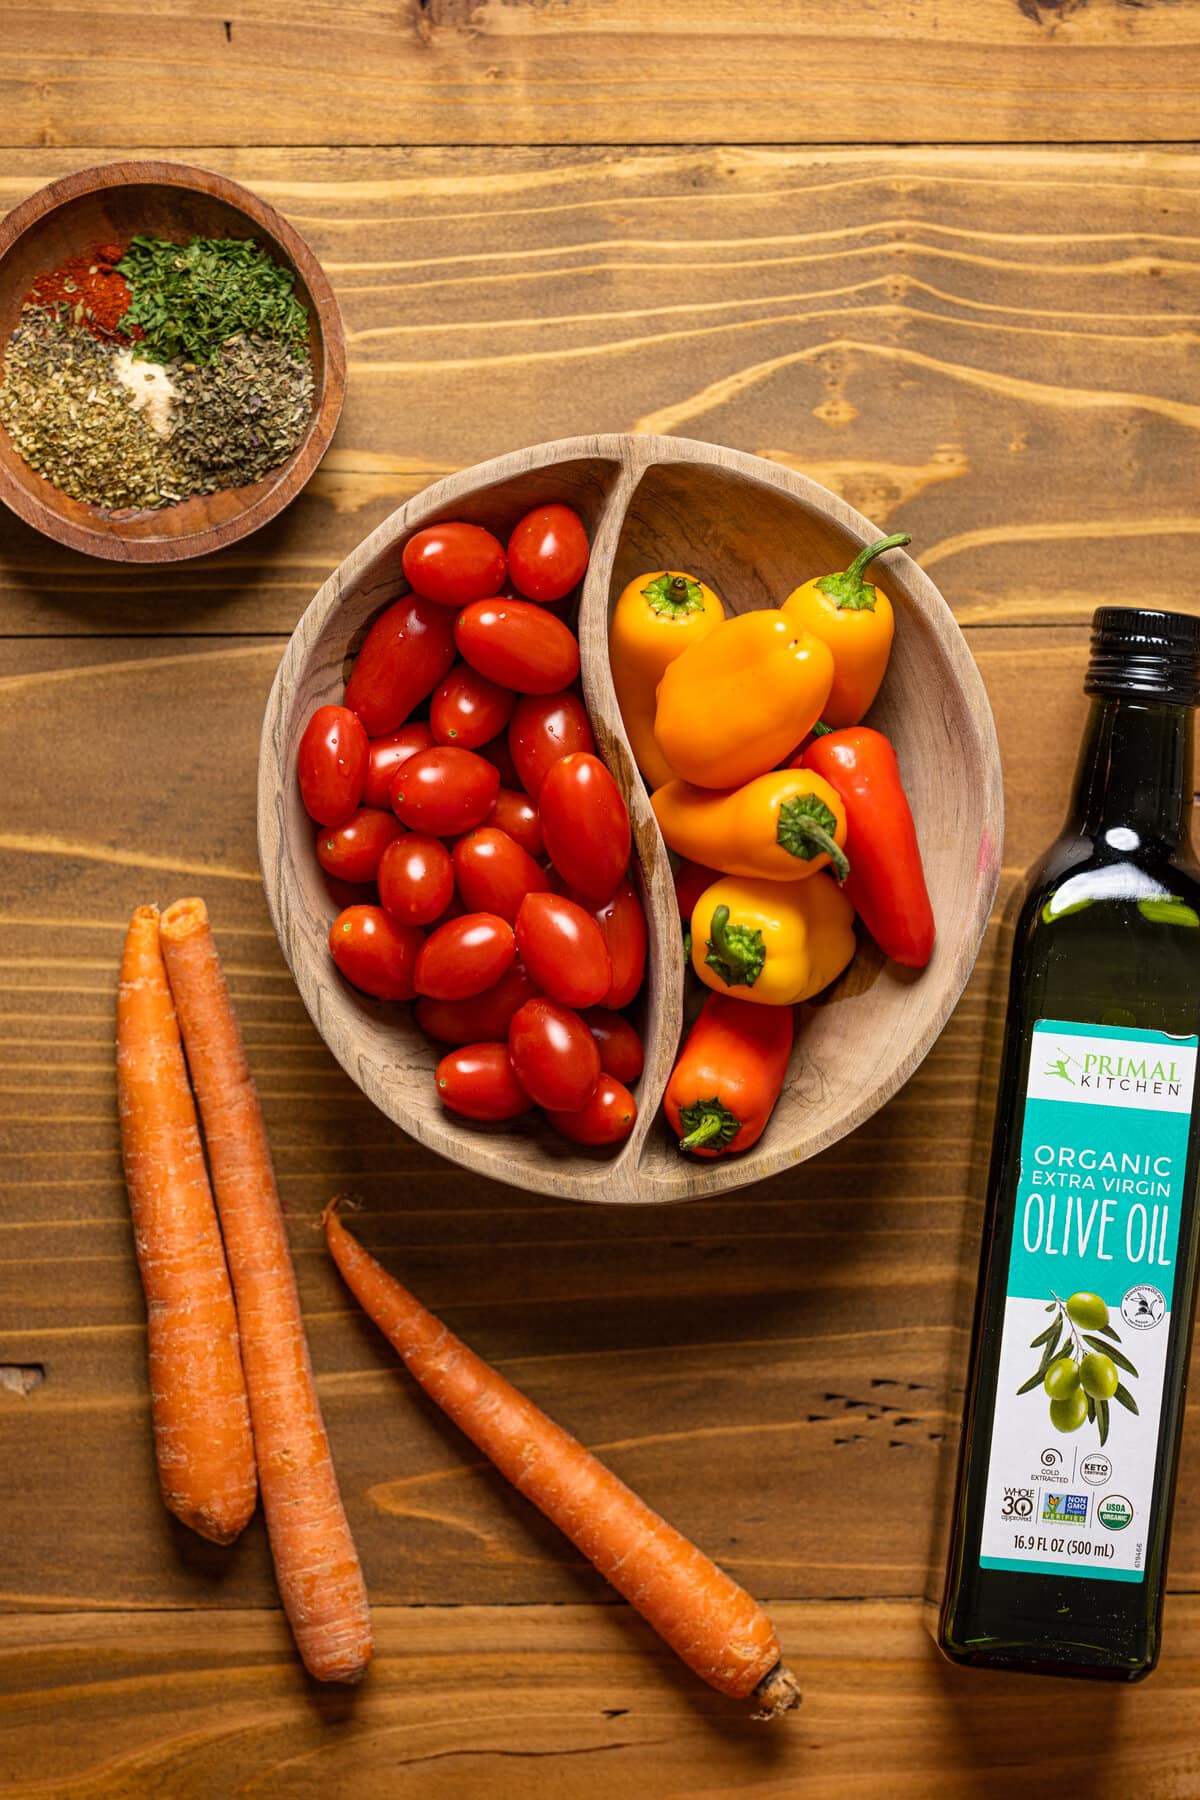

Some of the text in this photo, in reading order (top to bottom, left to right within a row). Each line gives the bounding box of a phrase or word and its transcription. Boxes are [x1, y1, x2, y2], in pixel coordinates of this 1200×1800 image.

[1082, 1053, 1181, 1083] PRIMAL
[1081, 1075, 1180, 1096] KITCHEN
[1034, 1145, 1172, 1177] ORGANIC
[1031, 1170, 1171, 1198] EXTRA VIRGIN
[1023, 1193, 1171, 1265] OLIVE OIL
[1041, 1468, 1060, 1476] COLD
[1084, 1463, 1108, 1472] KETO
[1030, 1474, 1069, 1484] EXTRACTED
[1004, 1487, 1035, 1498] WHOLE
[1067, 1496, 1087, 1504] NON
[1001, 1496, 1034, 1517] 30
[1067, 1502, 1086, 1510] GMO
[1106, 1503, 1126, 1513] USDA
[1044, 1512, 1085, 1522] VERIFIED
[1102, 1513, 1129, 1522] ORGANIC
[1014, 1535, 1115, 1559] 16.9 FL OZ (500 mL)
